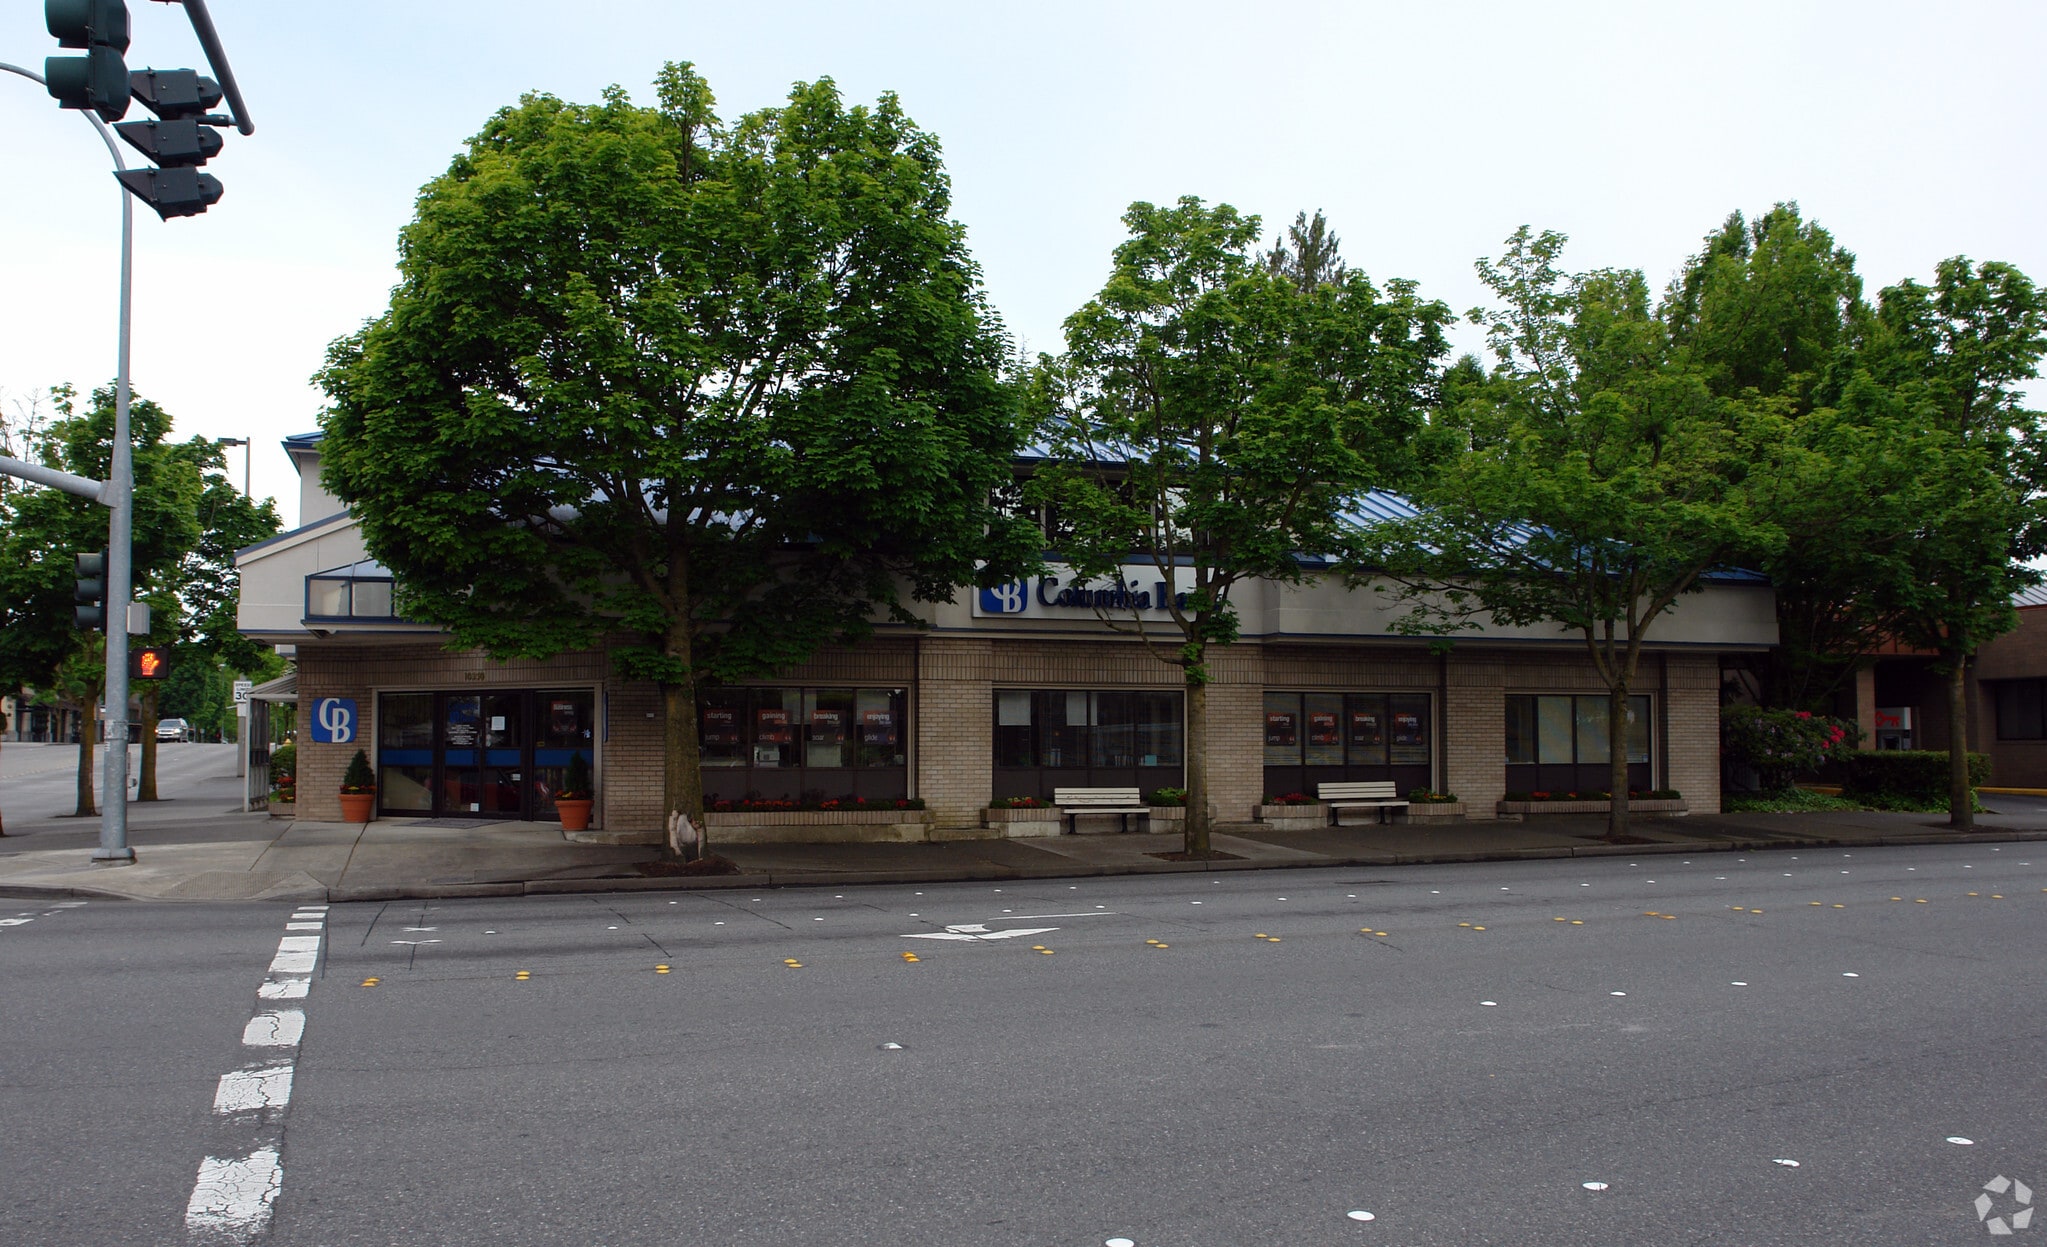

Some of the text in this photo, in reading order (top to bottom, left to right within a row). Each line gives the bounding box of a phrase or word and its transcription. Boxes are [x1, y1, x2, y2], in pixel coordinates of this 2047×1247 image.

[319, 697, 351, 743] CB
[706, 711, 732, 721] starting
[761, 711, 786, 721] gaining
